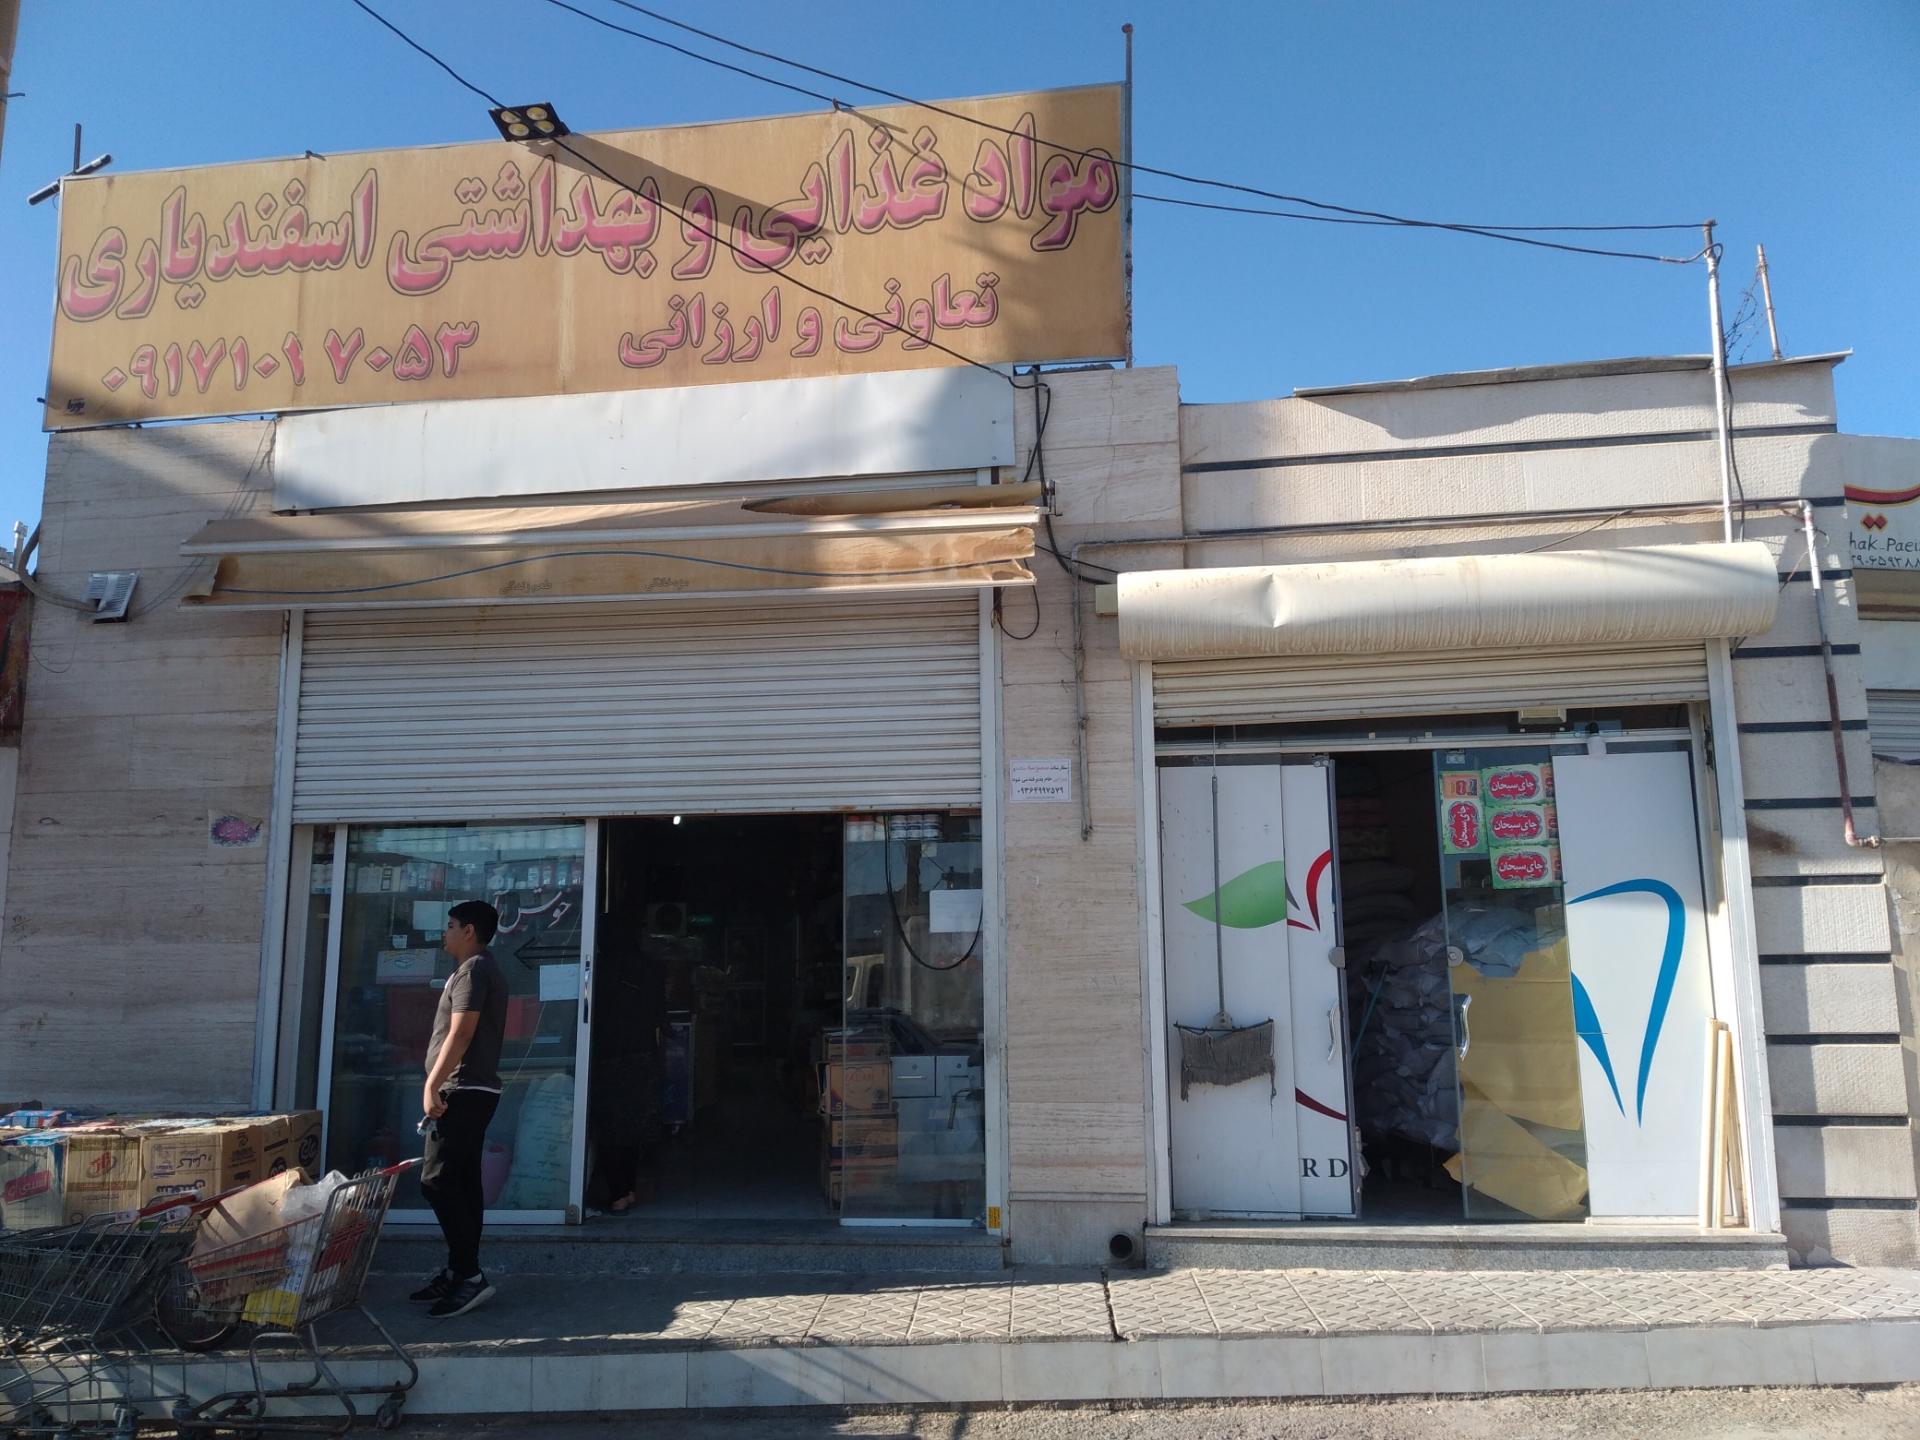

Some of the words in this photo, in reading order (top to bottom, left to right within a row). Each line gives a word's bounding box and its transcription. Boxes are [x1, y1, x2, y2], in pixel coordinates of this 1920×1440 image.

[387, 154, 661, 297] بهداشتی
[671, 185, 717, 280] و
[732, 124, 950, 273] غذایی
[963, 112, 1119, 252] مواد
[61, 168, 377, 323] اسفندیاری
[619, 285, 780, 367] ارزانی
[791, 306, 823, 358] و
[834, 271, 1000, 352] تعاونی
